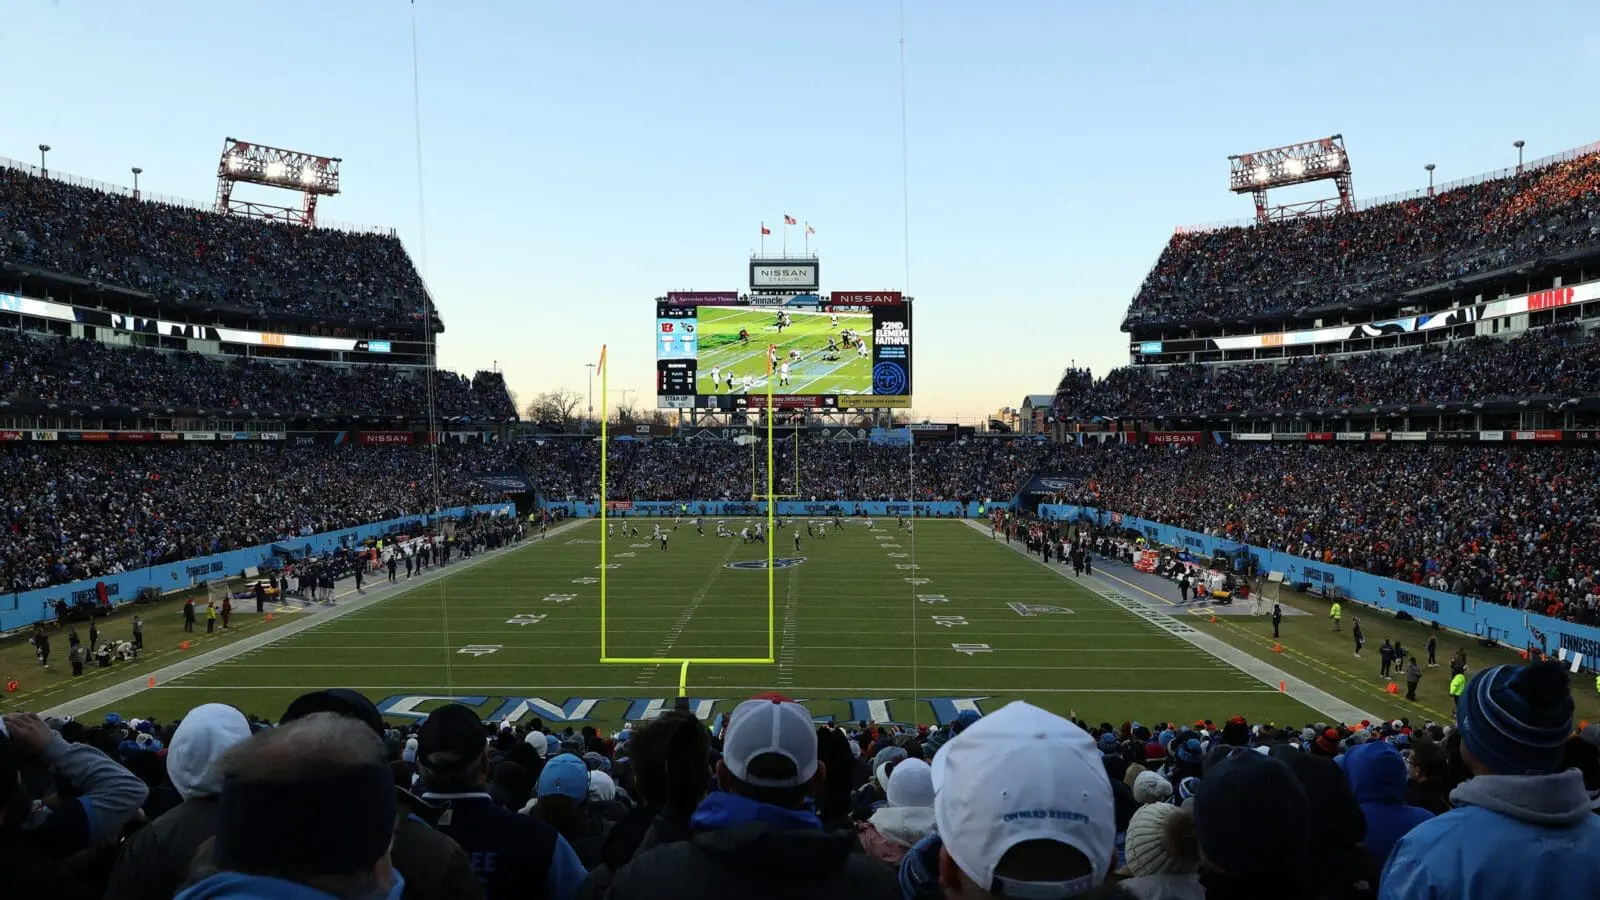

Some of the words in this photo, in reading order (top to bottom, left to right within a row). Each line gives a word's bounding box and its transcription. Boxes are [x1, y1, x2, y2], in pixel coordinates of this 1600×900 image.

[750, 296, 783, 305] Pinnacle
[840, 295, 893, 303] NISSAN
[881, 321, 904, 330] 22ND
[875, 329, 909, 337] ELEMENT
[875, 336, 909, 345] FAITHFUL
